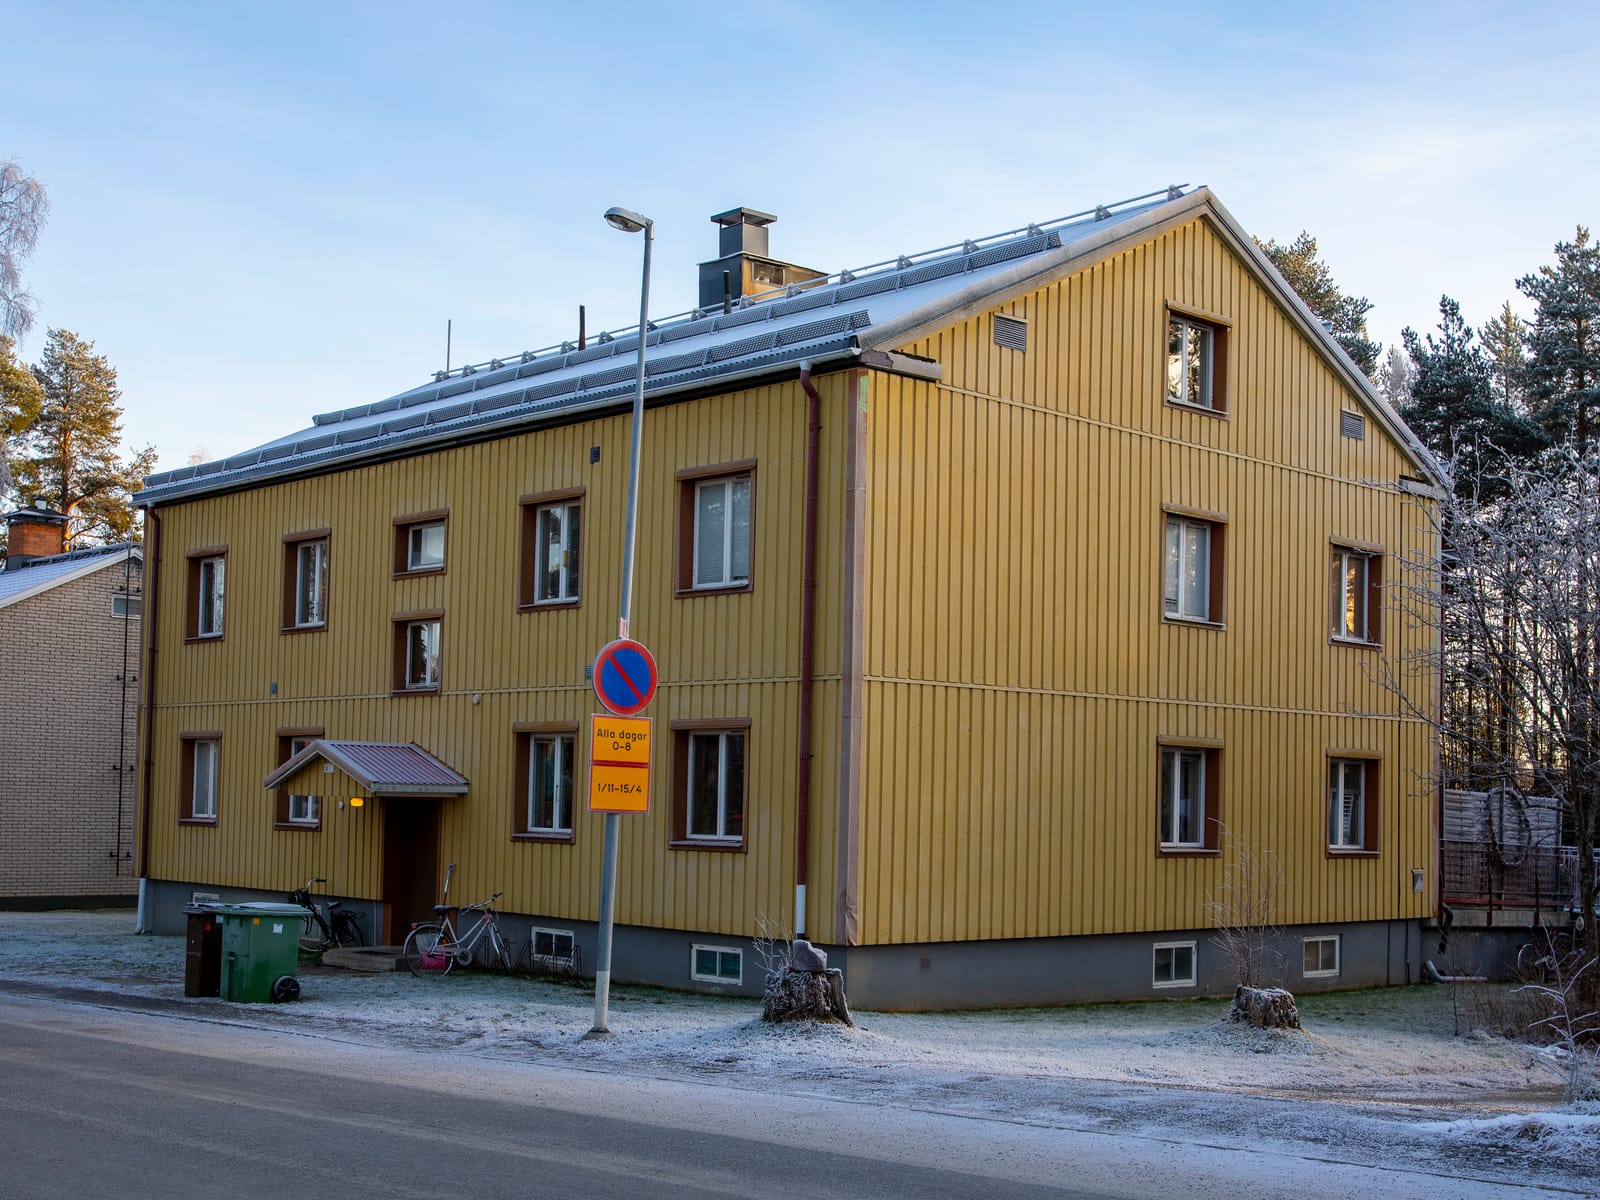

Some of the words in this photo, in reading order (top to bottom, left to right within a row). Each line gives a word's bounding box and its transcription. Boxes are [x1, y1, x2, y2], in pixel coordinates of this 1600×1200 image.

[597, 728, 616, 739] Alla
[618, 730, 648, 742] dagar
[612, 741, 632, 751] 0-8
[597, 782, 642, 794] 1/11-15/4
